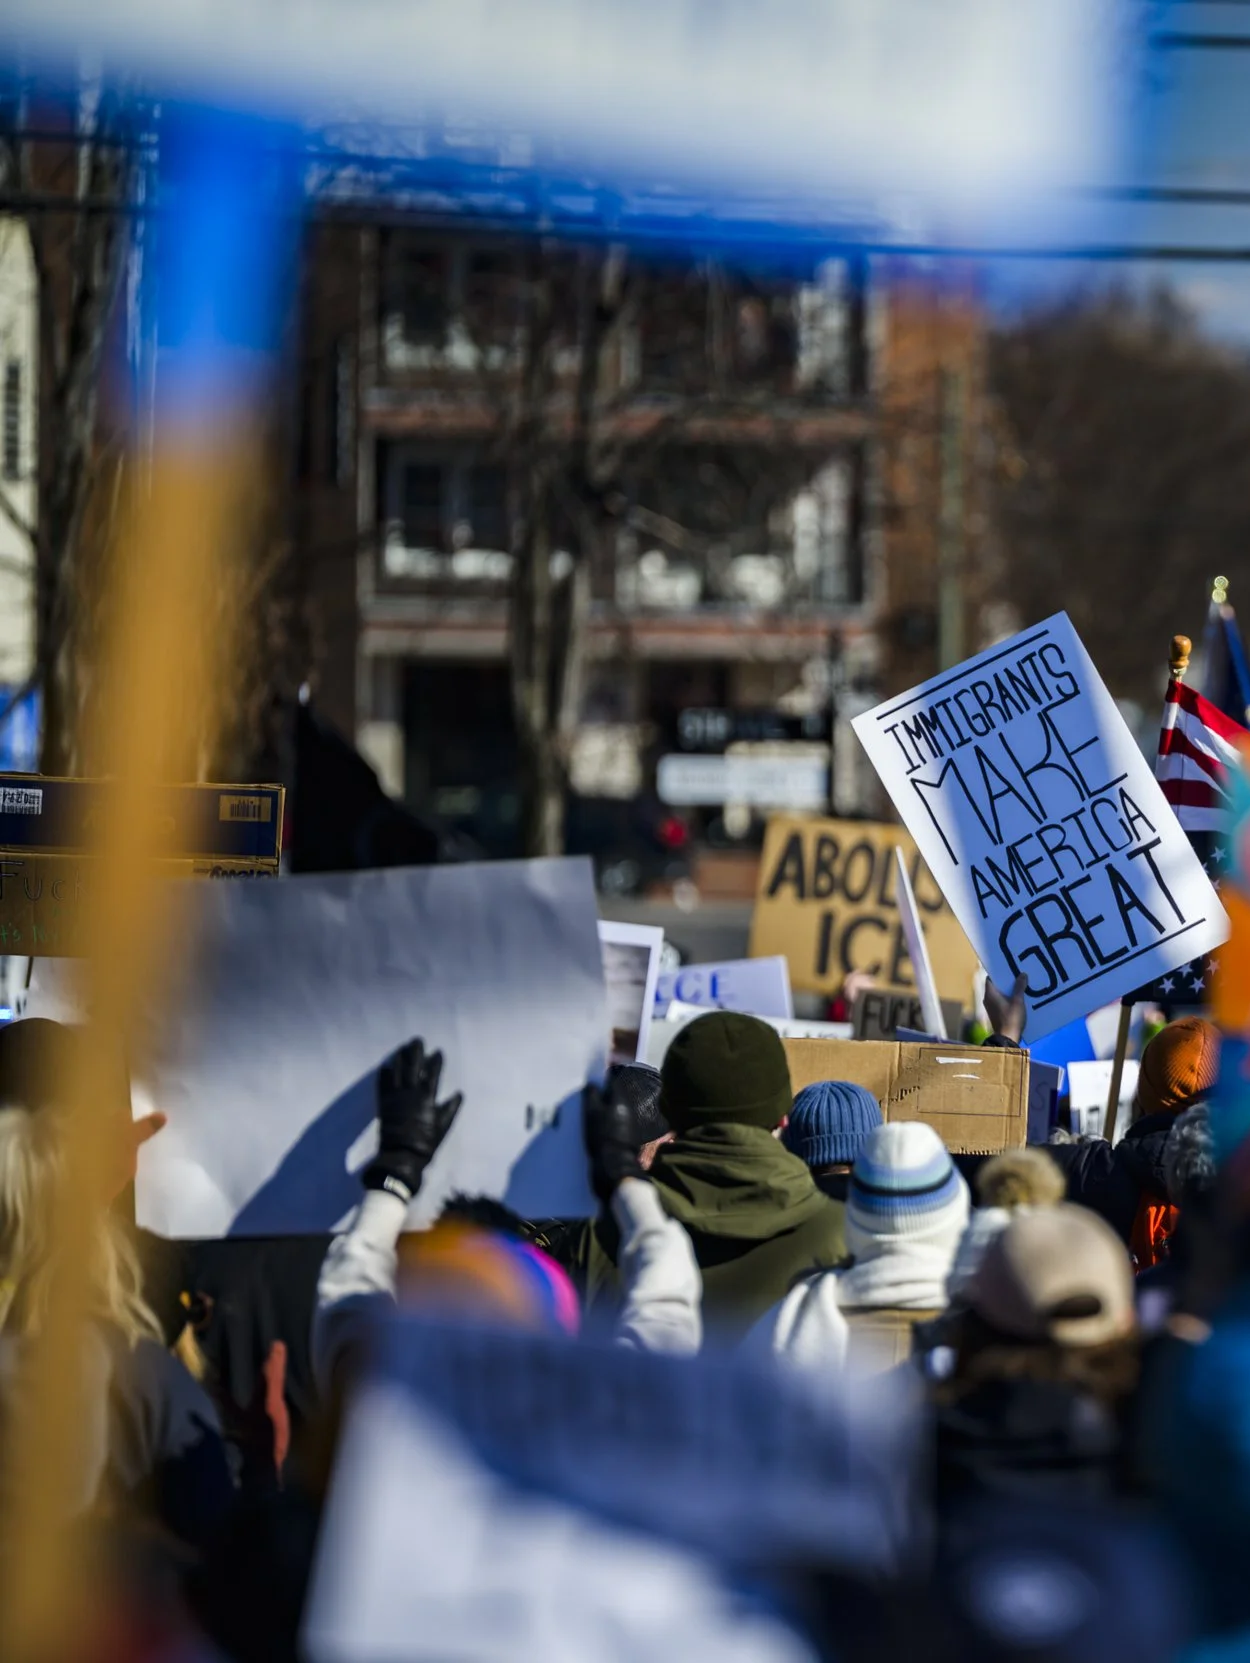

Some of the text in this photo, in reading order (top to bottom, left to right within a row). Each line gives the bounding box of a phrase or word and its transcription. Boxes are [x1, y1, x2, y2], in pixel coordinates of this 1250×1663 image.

[884, 643, 1080, 775] IMMIGRANTS
[910, 692, 1128, 866] MAKE
[970, 787, 1157, 919] AMERICA
[998, 836, 1186, 998] GREAT
[815, 910, 927, 987] ICE
